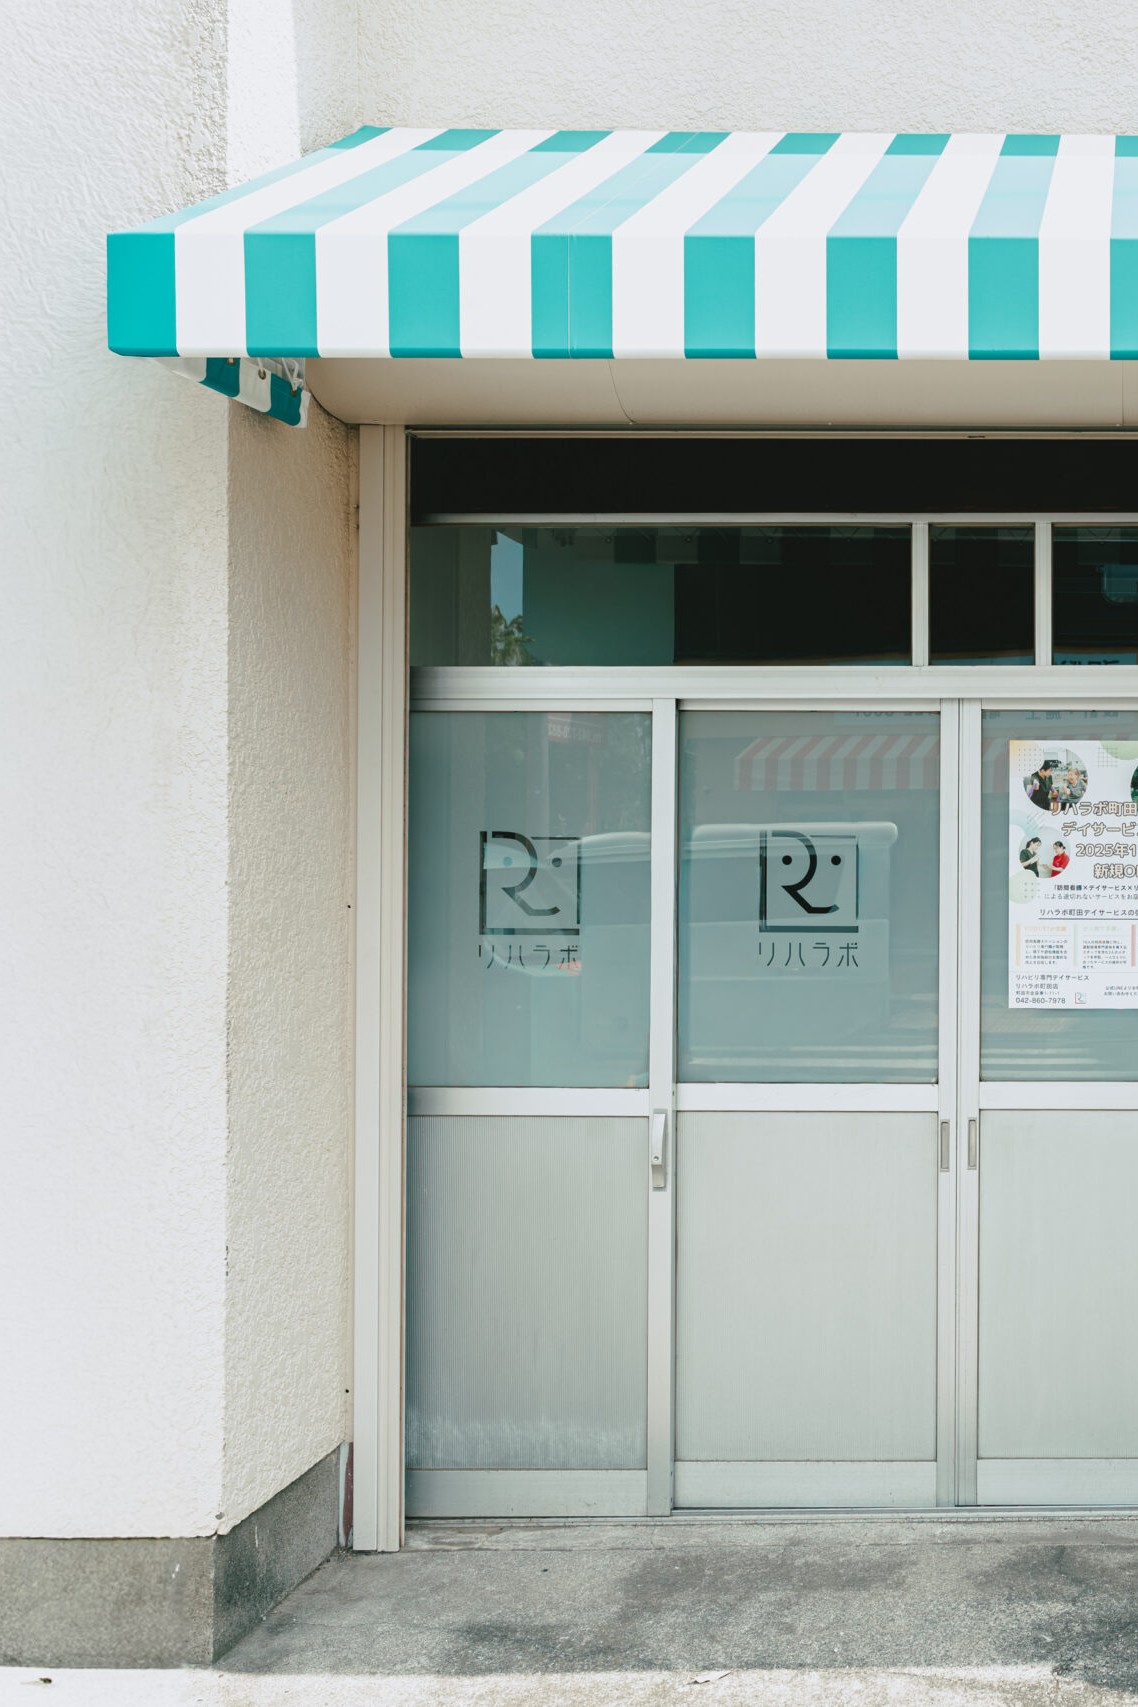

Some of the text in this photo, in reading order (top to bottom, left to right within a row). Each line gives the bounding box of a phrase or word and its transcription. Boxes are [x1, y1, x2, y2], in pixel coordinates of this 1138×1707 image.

[1050, 801, 1138, 817] リハラボ町田
[478, 944, 579, 969] リハラボ
[758, 942, 859, 968] リハラボ
